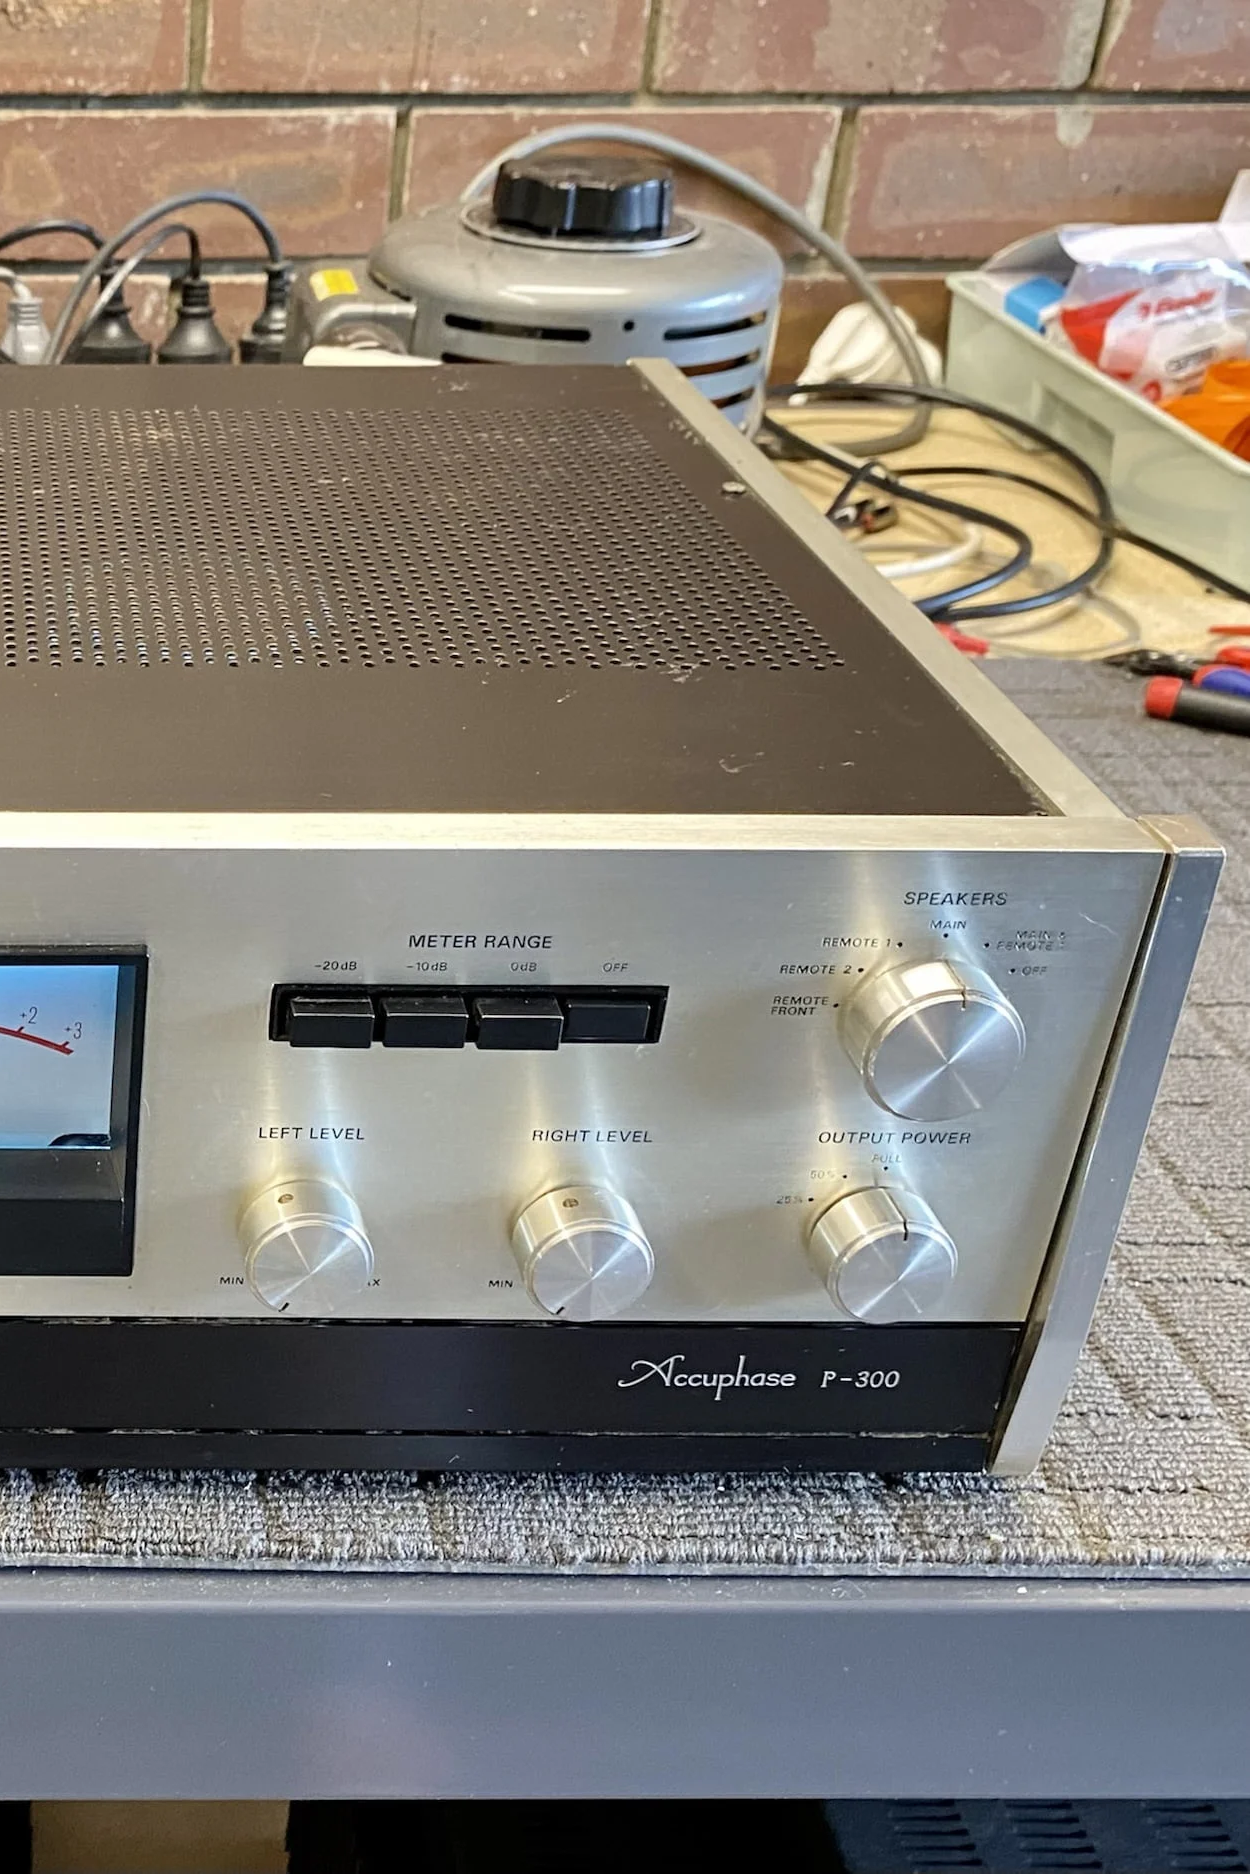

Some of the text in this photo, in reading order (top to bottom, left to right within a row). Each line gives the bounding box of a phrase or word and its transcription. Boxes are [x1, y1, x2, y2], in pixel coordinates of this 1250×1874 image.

[903, 891, 1008, 906] SPEAKERS
[929, 919, 967, 930] MAIN
[408, 934, 554, 950] METER RANGE
[822, 937, 879, 948] REMOTE
[313, 960, 629, 973] -20dB -10dB 0dB OFF
[779, 964, 853, 975] REMOTE 2
[1021, 965, 1048, 976] OFF
[772, 996, 830, 1007] REMOTE
[770, 1006, 817, 1016] FRONT
[19, 1006, 39, 1025] +2
[63, 1021, 83, 1040] +3
[257, 1126, 366, 1140] LEFT LEVEL
[531, 1129, 654, 1143] RIGHT LEVEL
[818, 1131, 972, 1145] OUTPUT POWER
[871, 1153, 903, 1163] FULL
[219, 1276, 245, 1285] MIN
[488, 1279, 514, 1288] MIN
[617, 1354, 901, 1401] Accuphase P-300
